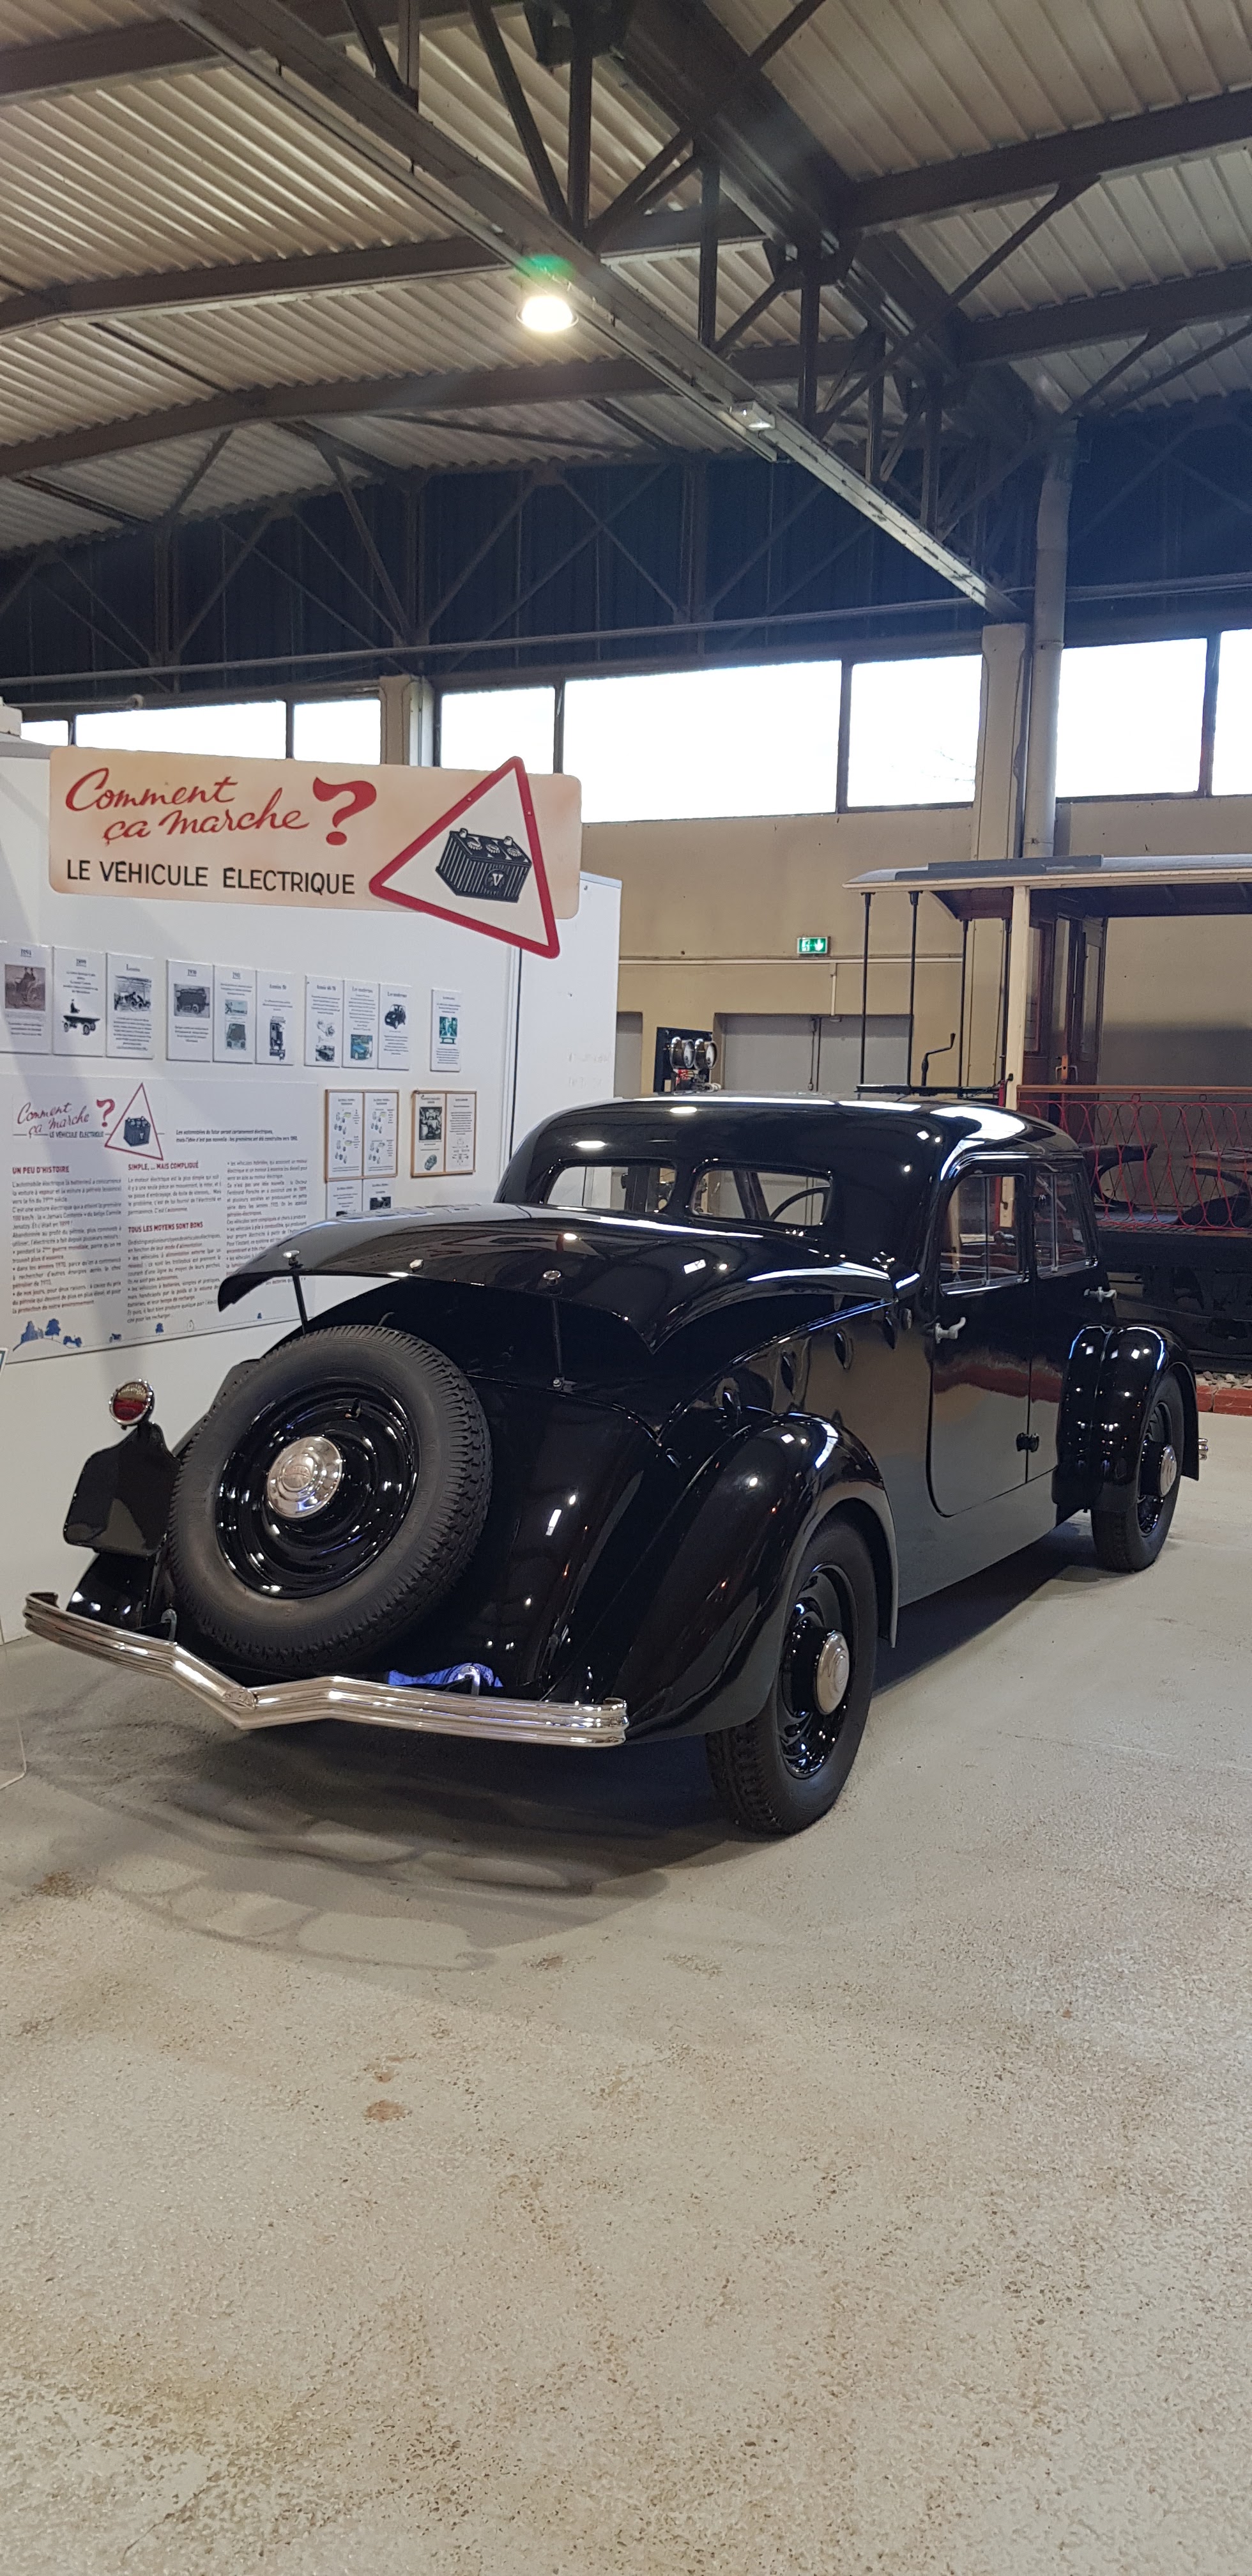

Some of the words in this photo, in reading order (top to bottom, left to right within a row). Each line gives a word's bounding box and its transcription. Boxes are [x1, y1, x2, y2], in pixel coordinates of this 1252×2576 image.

[66, 767, 241, 811] Comment
[102, 811, 151, 846] ça
[158, 788, 309, 836] marche
[313, 777, 377, 846] ?
[67, 860, 91, 882] LE
[100, 861, 208, 887] VÉHICULE
[222, 868, 356, 896] ÉLECTRIQUE
[17, 1102, 72, 1124] Comment
[28, 1124, 43, 1139] ça
[49, 1106, 89, 1130] marche
